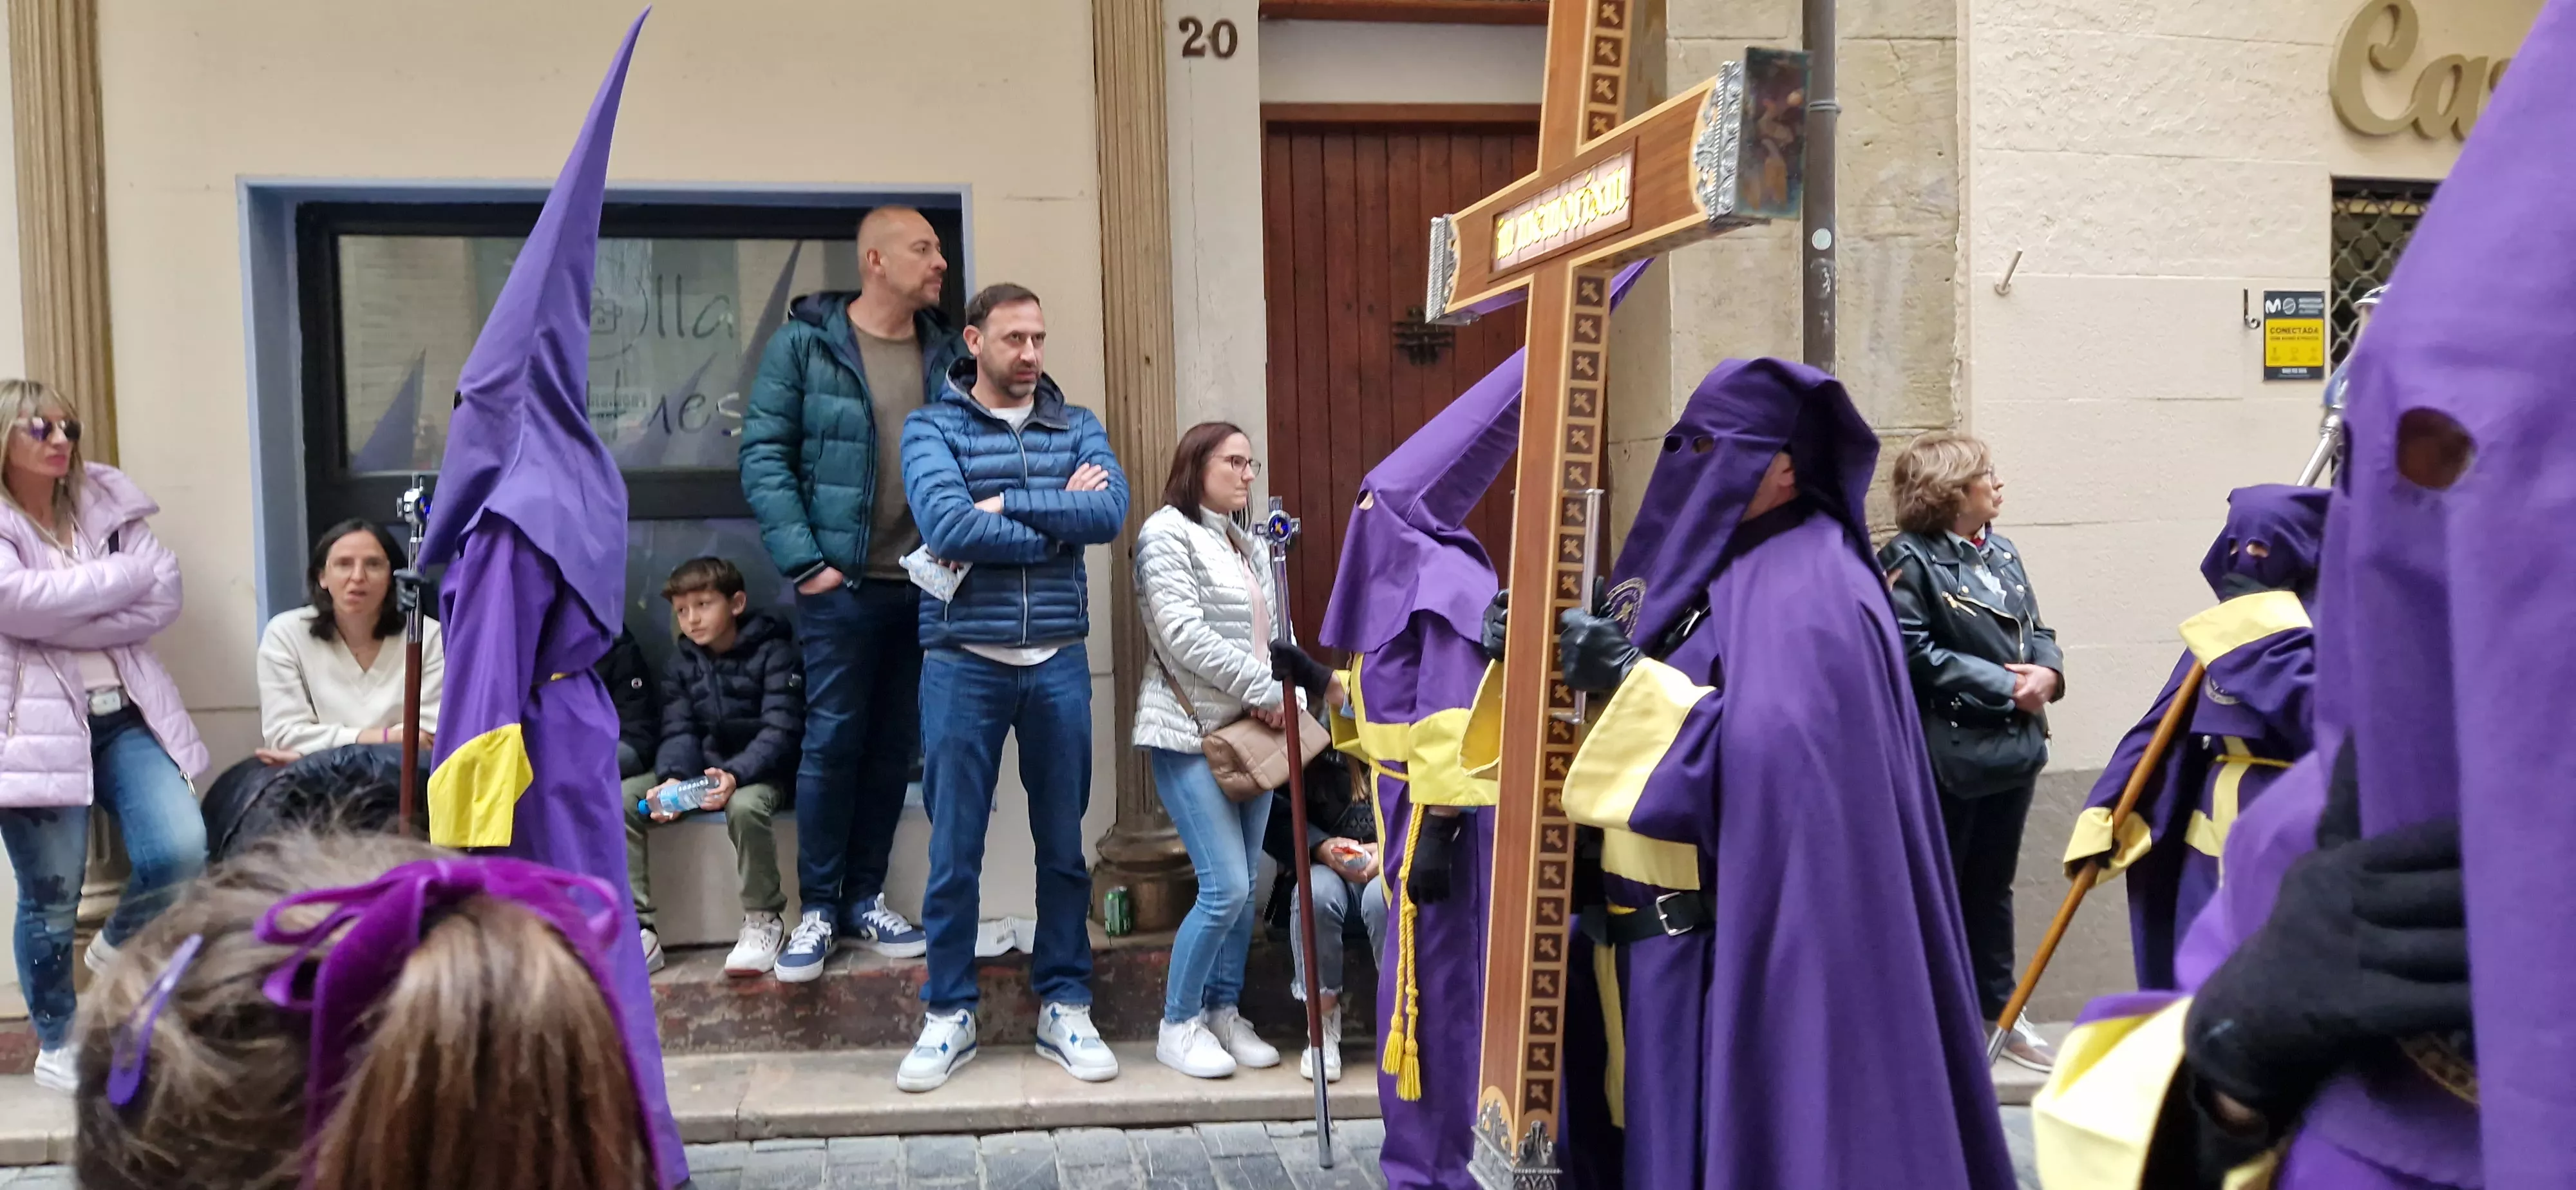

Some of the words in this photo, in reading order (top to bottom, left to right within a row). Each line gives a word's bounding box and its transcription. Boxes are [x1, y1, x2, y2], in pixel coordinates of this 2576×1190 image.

[1178, 17, 1238, 59] 20
[2329, 0, 2513, 142] Ca
[1497, 218, 1515, 260] in
